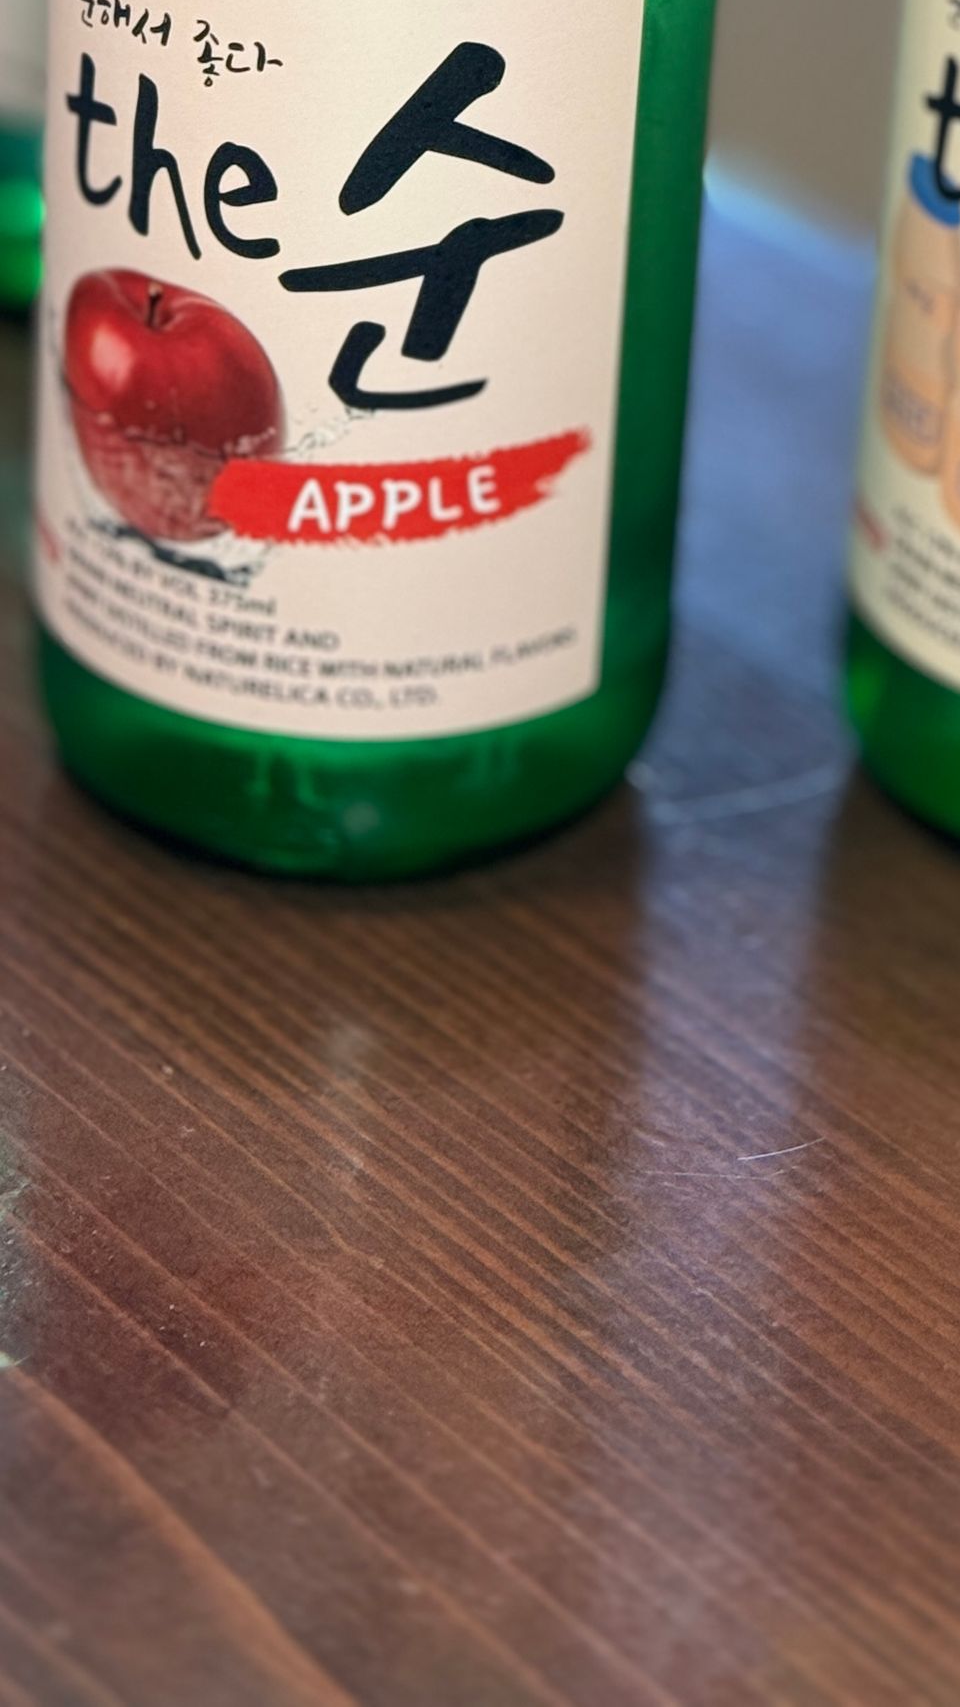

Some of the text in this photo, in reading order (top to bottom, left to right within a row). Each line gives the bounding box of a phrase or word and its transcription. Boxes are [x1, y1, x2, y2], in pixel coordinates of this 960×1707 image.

[193, 19, 283, 87] 좋다
[65, 41, 565, 411] the 순
[287, 466, 502, 534] APPLE
[206, 612, 276, 644] SPIRIT
[284, 627, 341, 653] AND
[262, 652, 310, 678] RICE
[317, 657, 379, 680] WITH
